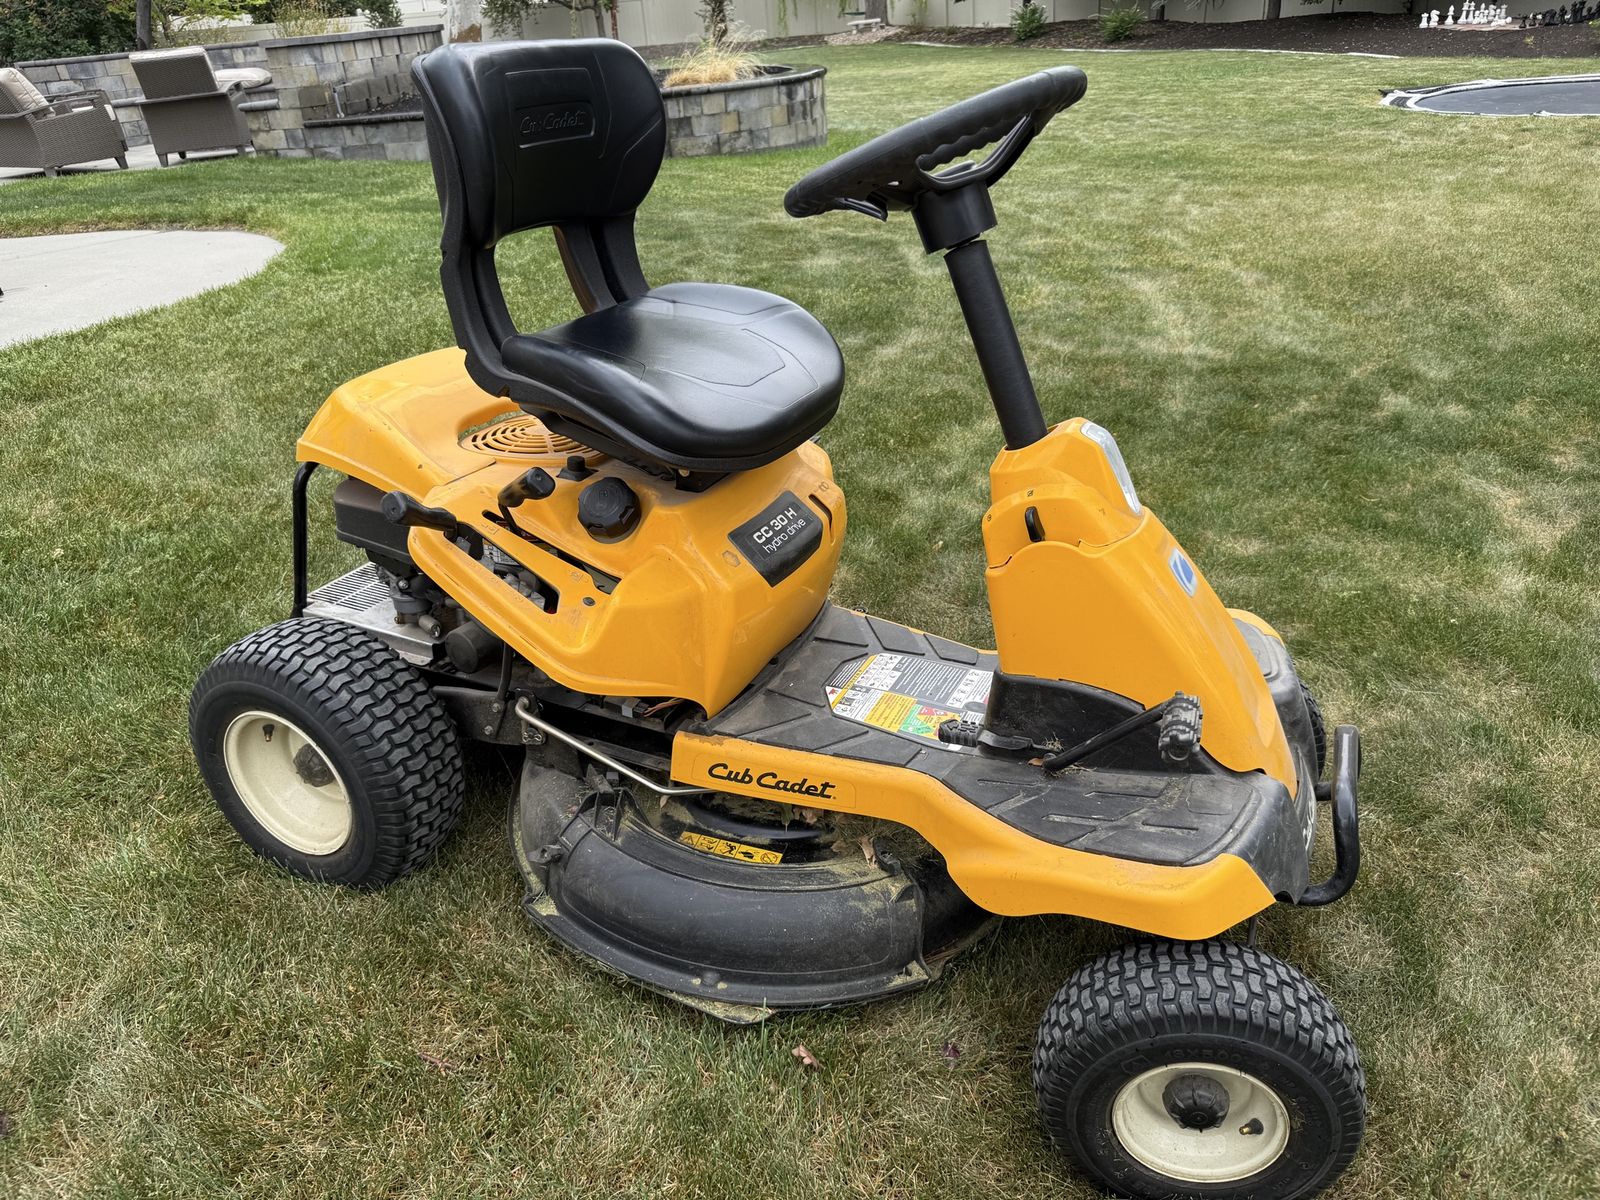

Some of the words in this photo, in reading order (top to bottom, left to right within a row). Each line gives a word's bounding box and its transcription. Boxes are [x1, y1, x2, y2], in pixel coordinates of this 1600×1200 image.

[752, 526, 774, 544] CC
[769, 514, 789, 531] 30
[784, 507, 798, 520] H
[762, 532, 789, 554] hydro
[786, 518, 807, 536] drive
[707, 762, 754, 784] Cub
[756, 771, 836, 799] Cadet
